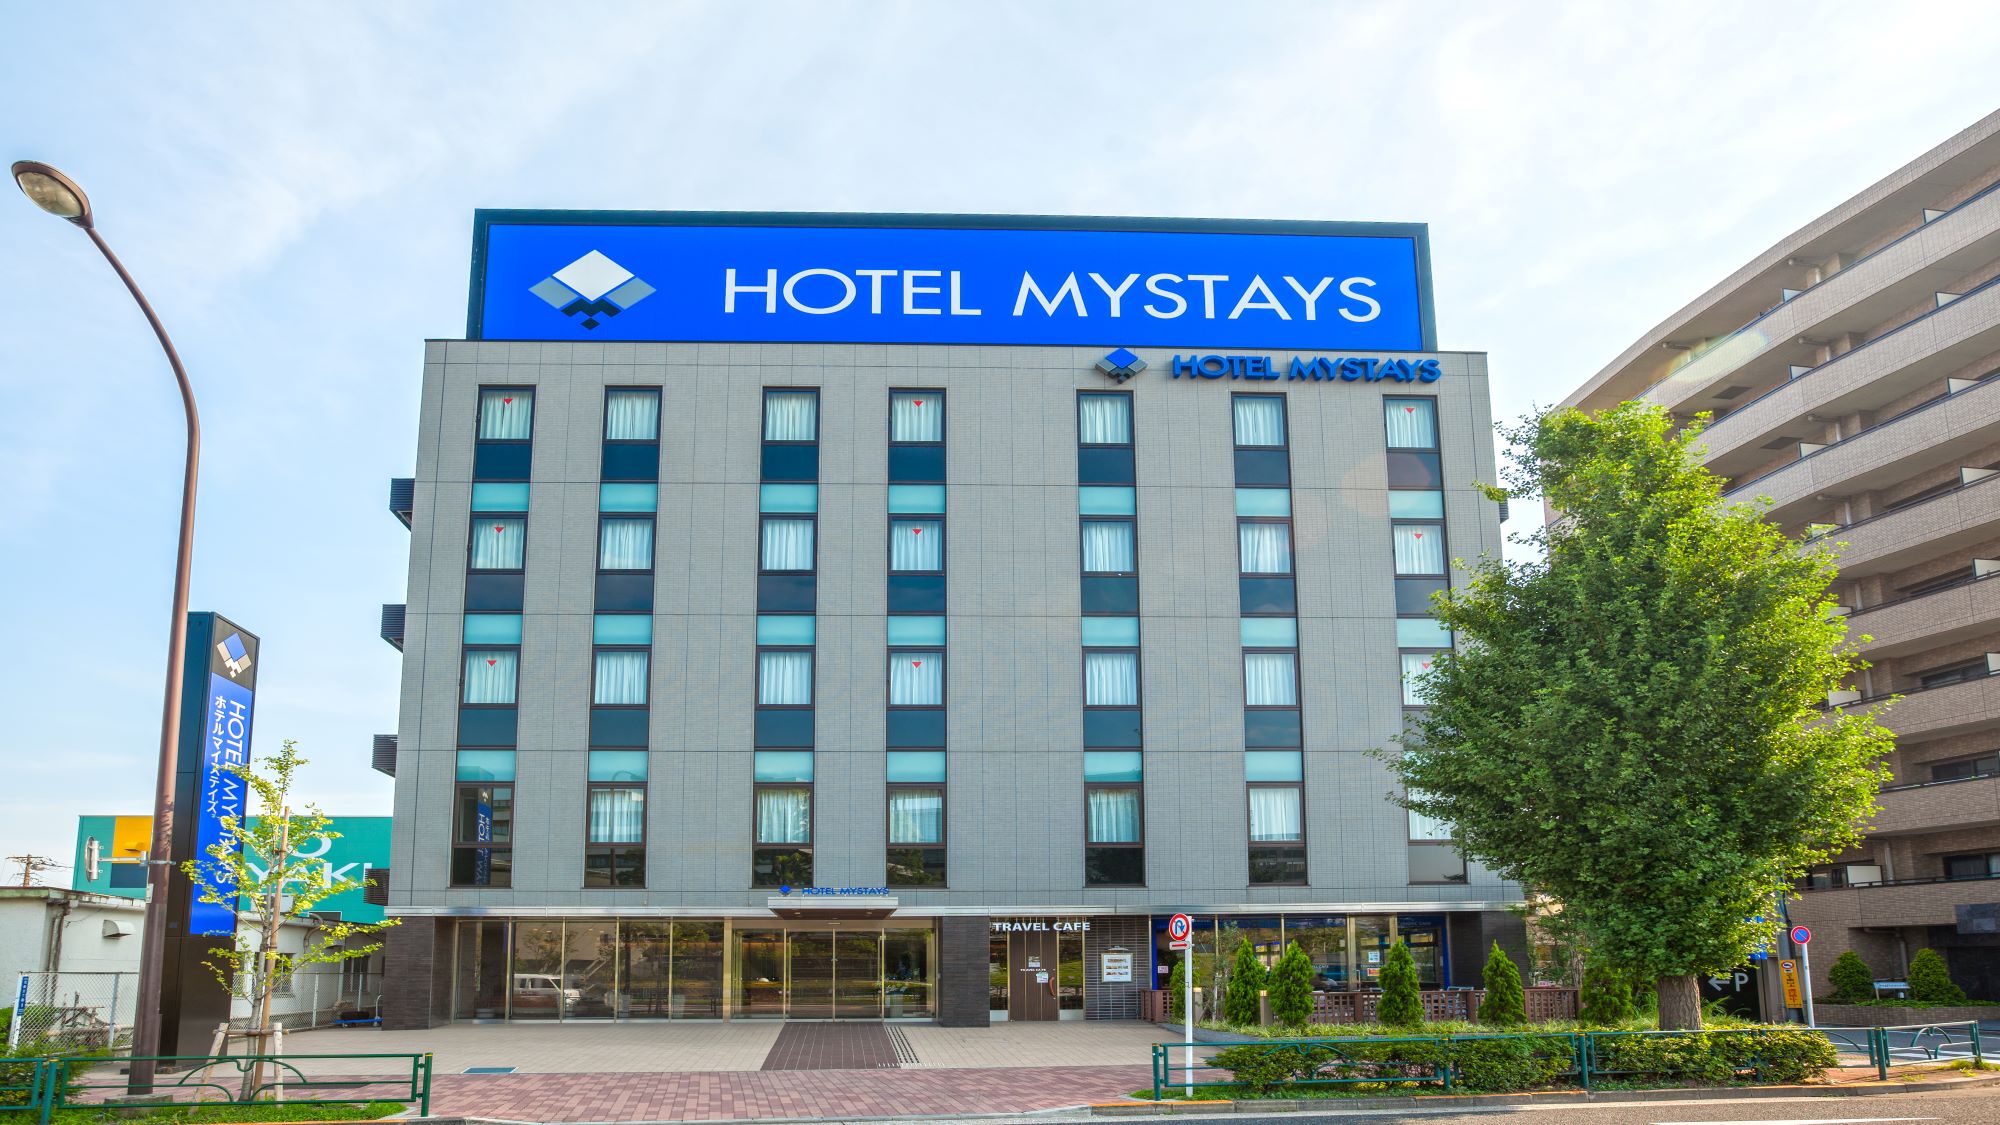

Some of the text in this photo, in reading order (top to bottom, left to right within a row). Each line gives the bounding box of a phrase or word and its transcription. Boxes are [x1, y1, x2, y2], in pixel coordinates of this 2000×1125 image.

[724, 267, 1382, 323] HOTEL MYSTAYS
[1172, 354, 1441, 383] HOTEL MYSTAYS
[801, 887, 890, 896] HOTEL MYSTAYS
[993, 922, 1091, 931] TRAVEL CAFE
[1735, 972, 1749, 991] P
